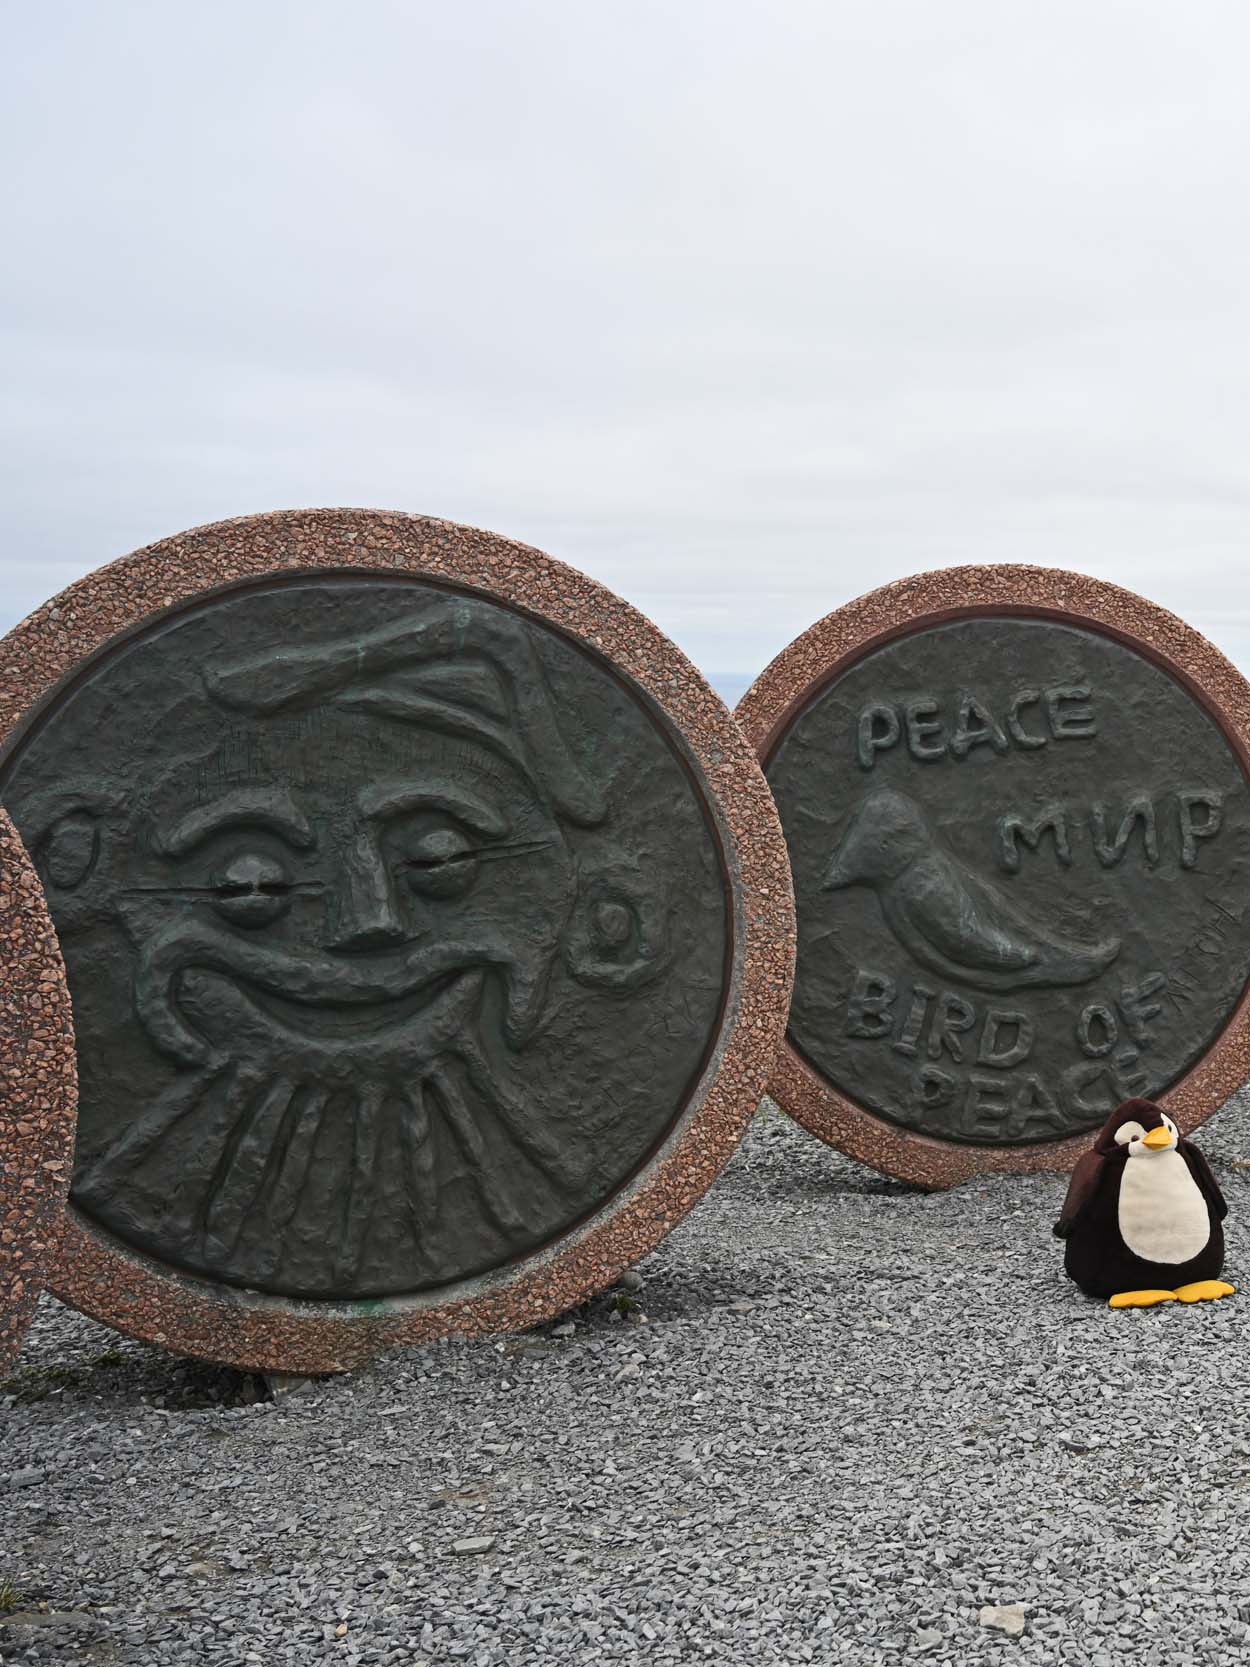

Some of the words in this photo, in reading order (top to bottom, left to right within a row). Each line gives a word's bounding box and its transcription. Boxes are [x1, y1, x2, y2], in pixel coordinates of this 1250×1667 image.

[858, 688, 1098, 768] PEACE
[848, 968, 1036, 1068] BIRD
[1077, 972, 1168, 1057] OF
[916, 1048, 1153, 1138] PEACE
